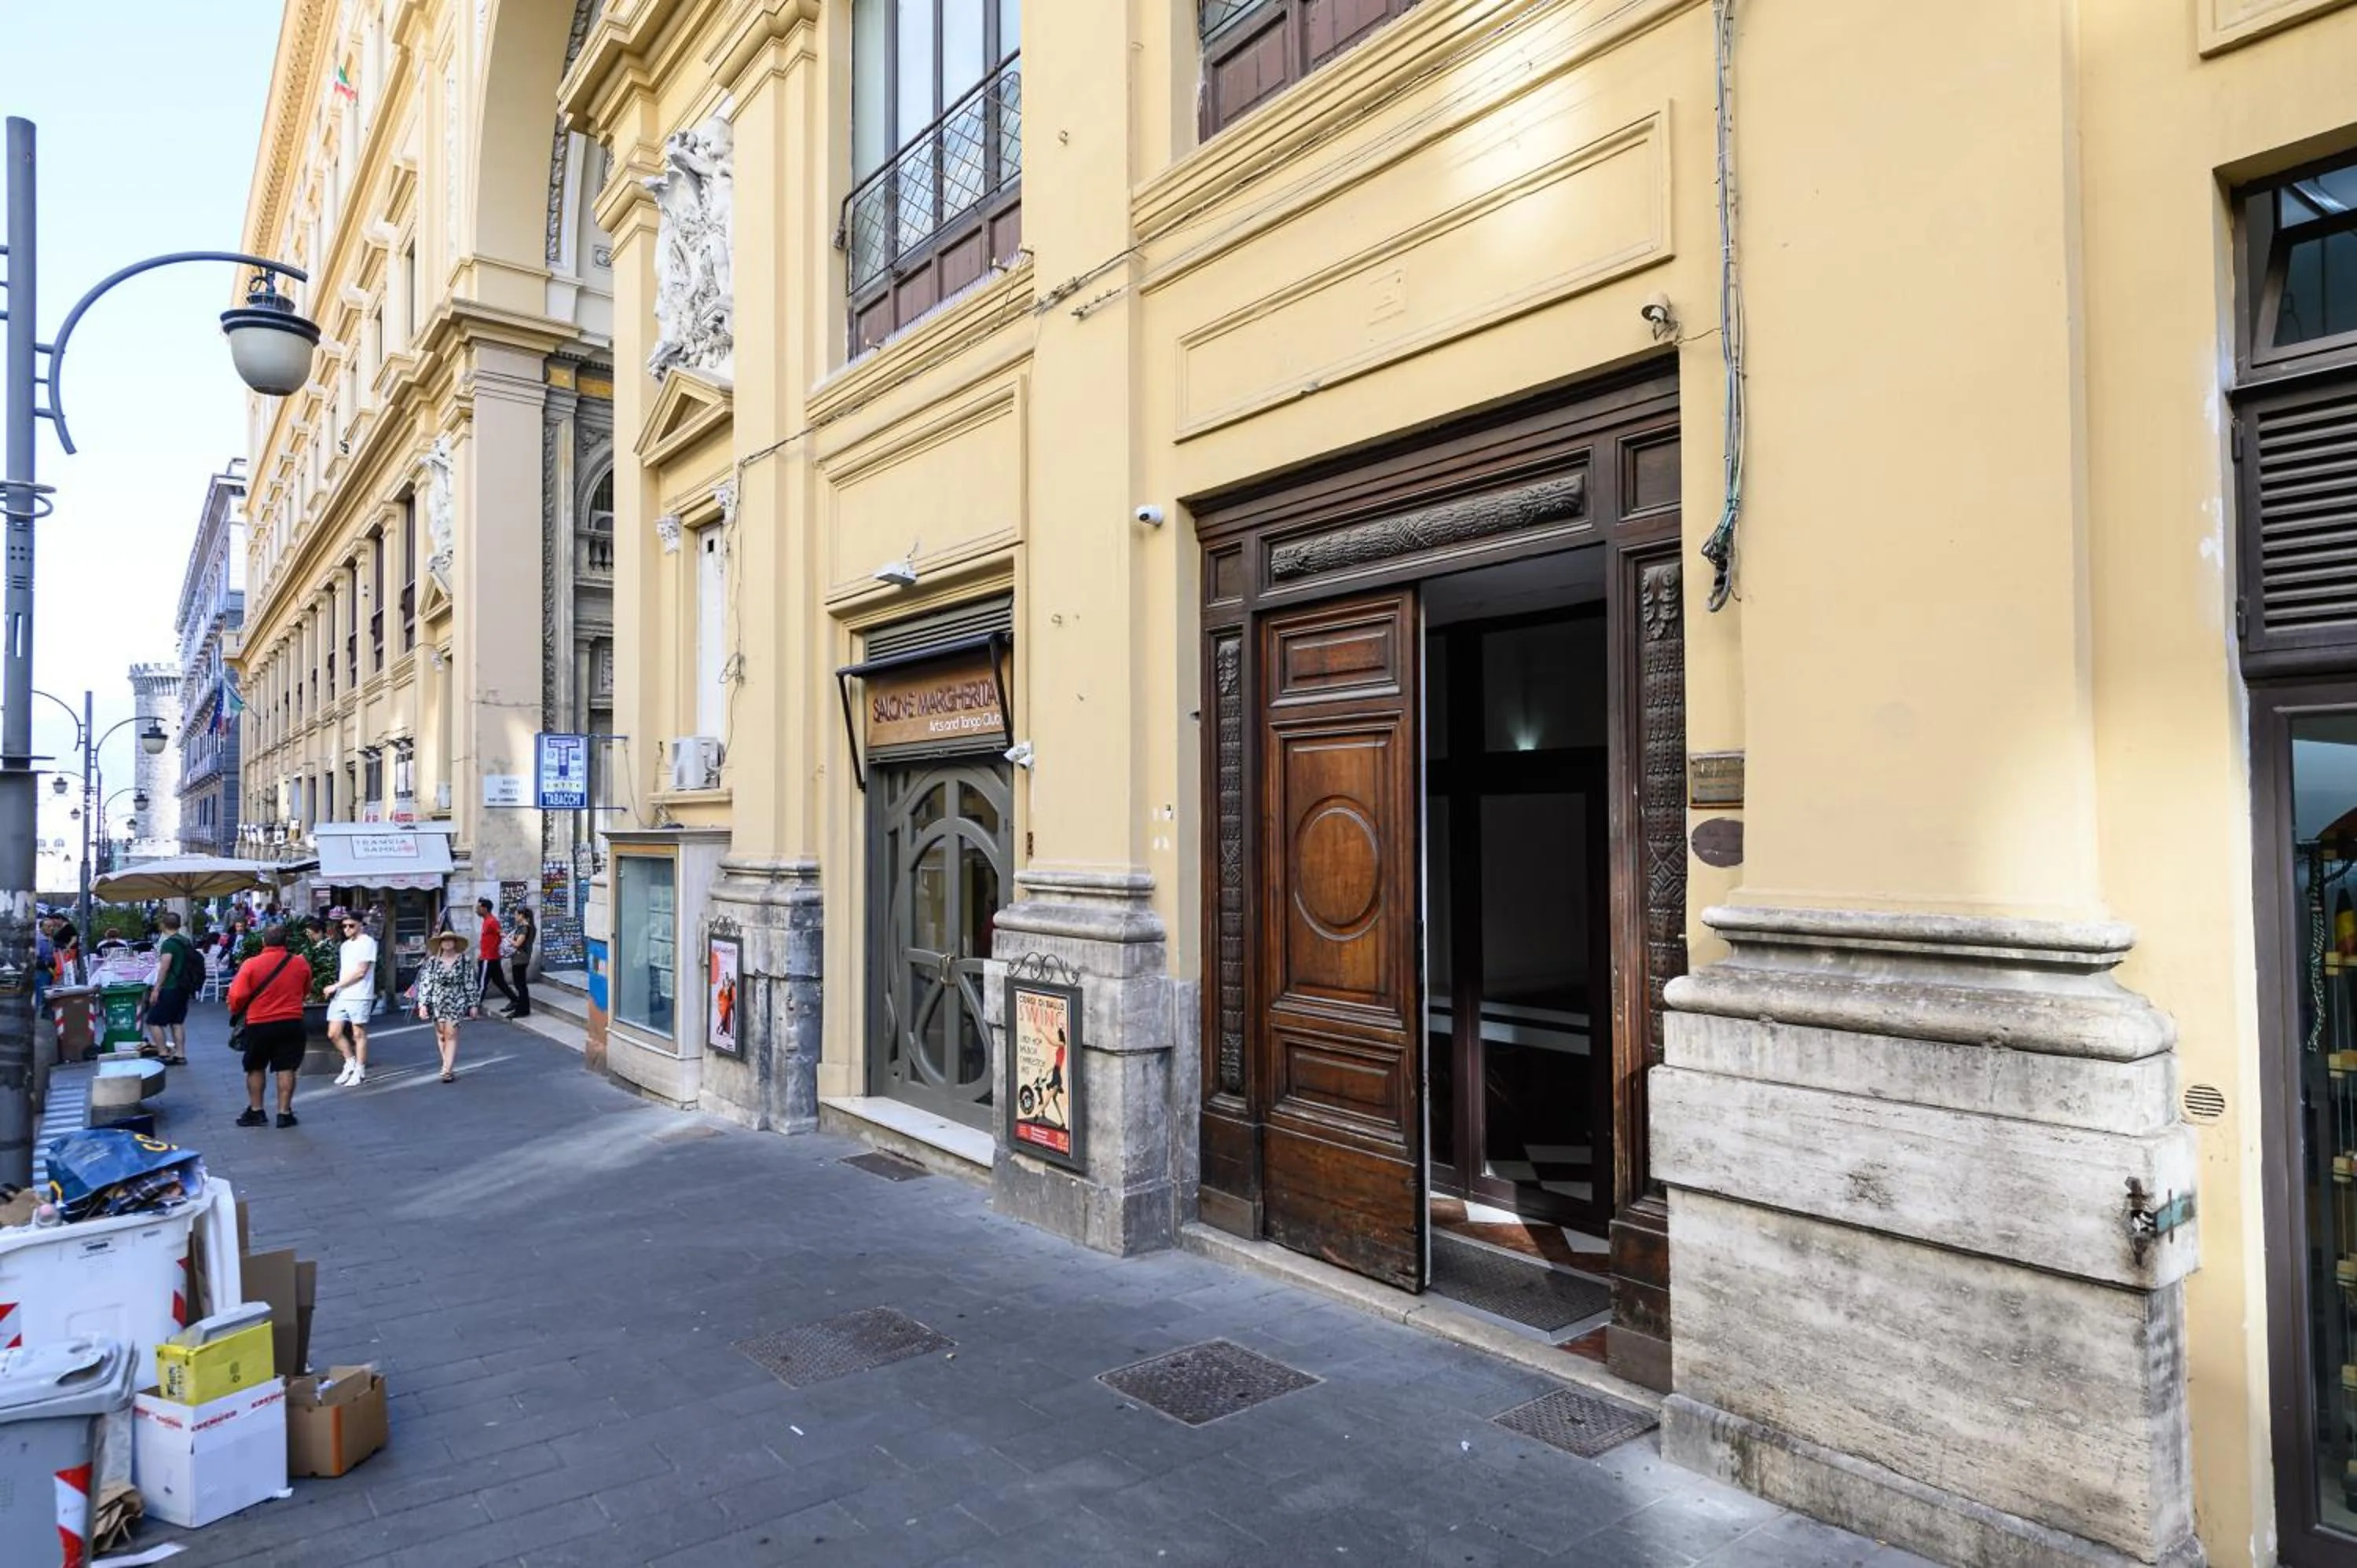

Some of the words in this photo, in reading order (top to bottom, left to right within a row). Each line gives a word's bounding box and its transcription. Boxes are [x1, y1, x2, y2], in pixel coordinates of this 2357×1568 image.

[873, 692, 915, 724] SALONE
[918, 678, 999, 717] MARGHERITA
[929, 720, 944, 732] Arts
[945, 716, 959, 731] and
[959, 716, 981, 732] Tango
[983, 712, 1003, 727] Club
[544, 793, 581, 805] TABACCHI
[1019, 1003, 1064, 1028] SWING
